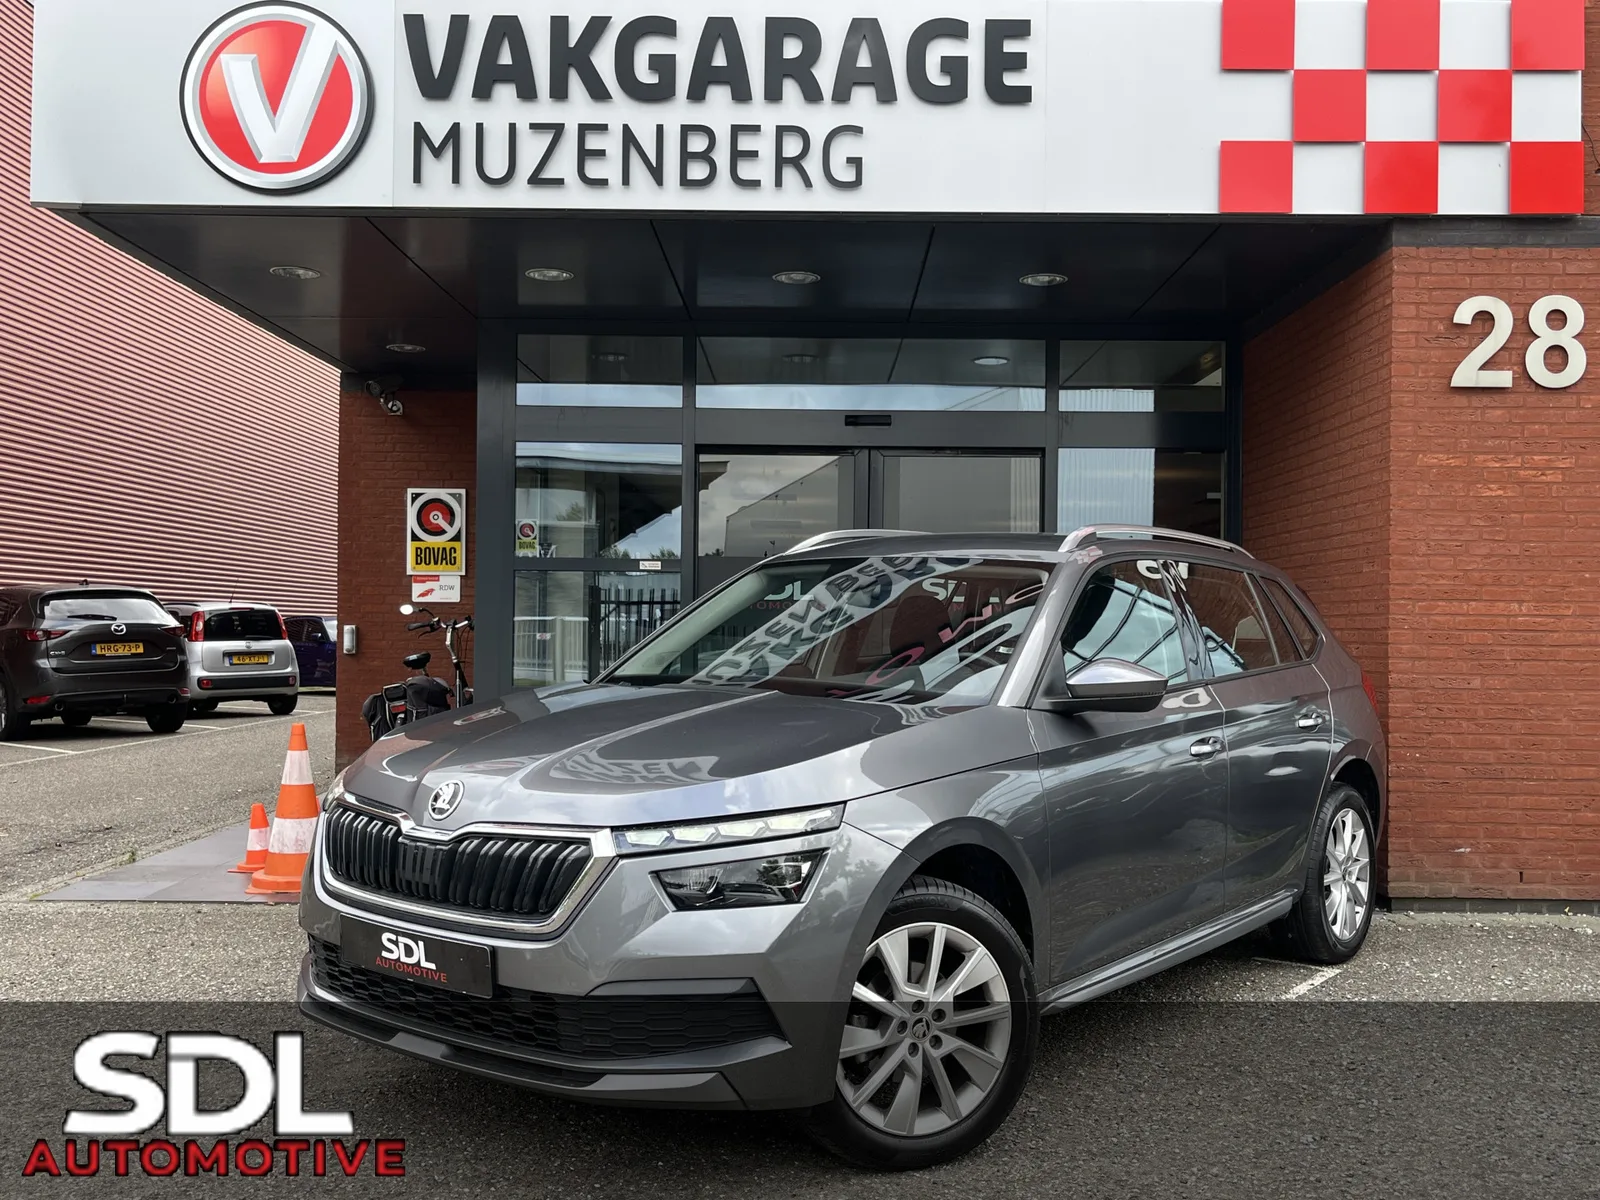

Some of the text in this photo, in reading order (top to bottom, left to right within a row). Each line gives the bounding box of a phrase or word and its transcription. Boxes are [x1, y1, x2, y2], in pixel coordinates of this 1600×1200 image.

[404, 14, 1032, 105] VAKGARAGE
[413, 121, 864, 190] MUZENBERG
[1450, 294, 1587, 390] 28
[415, 546, 457, 566] BOVAG
[518, 541, 536, 550] BOVAG
[100, 643, 141, 653] HRG-73-P
[381, 931, 437, 971] SDL
[375, 956, 448, 983] AUTOMOTIVE
